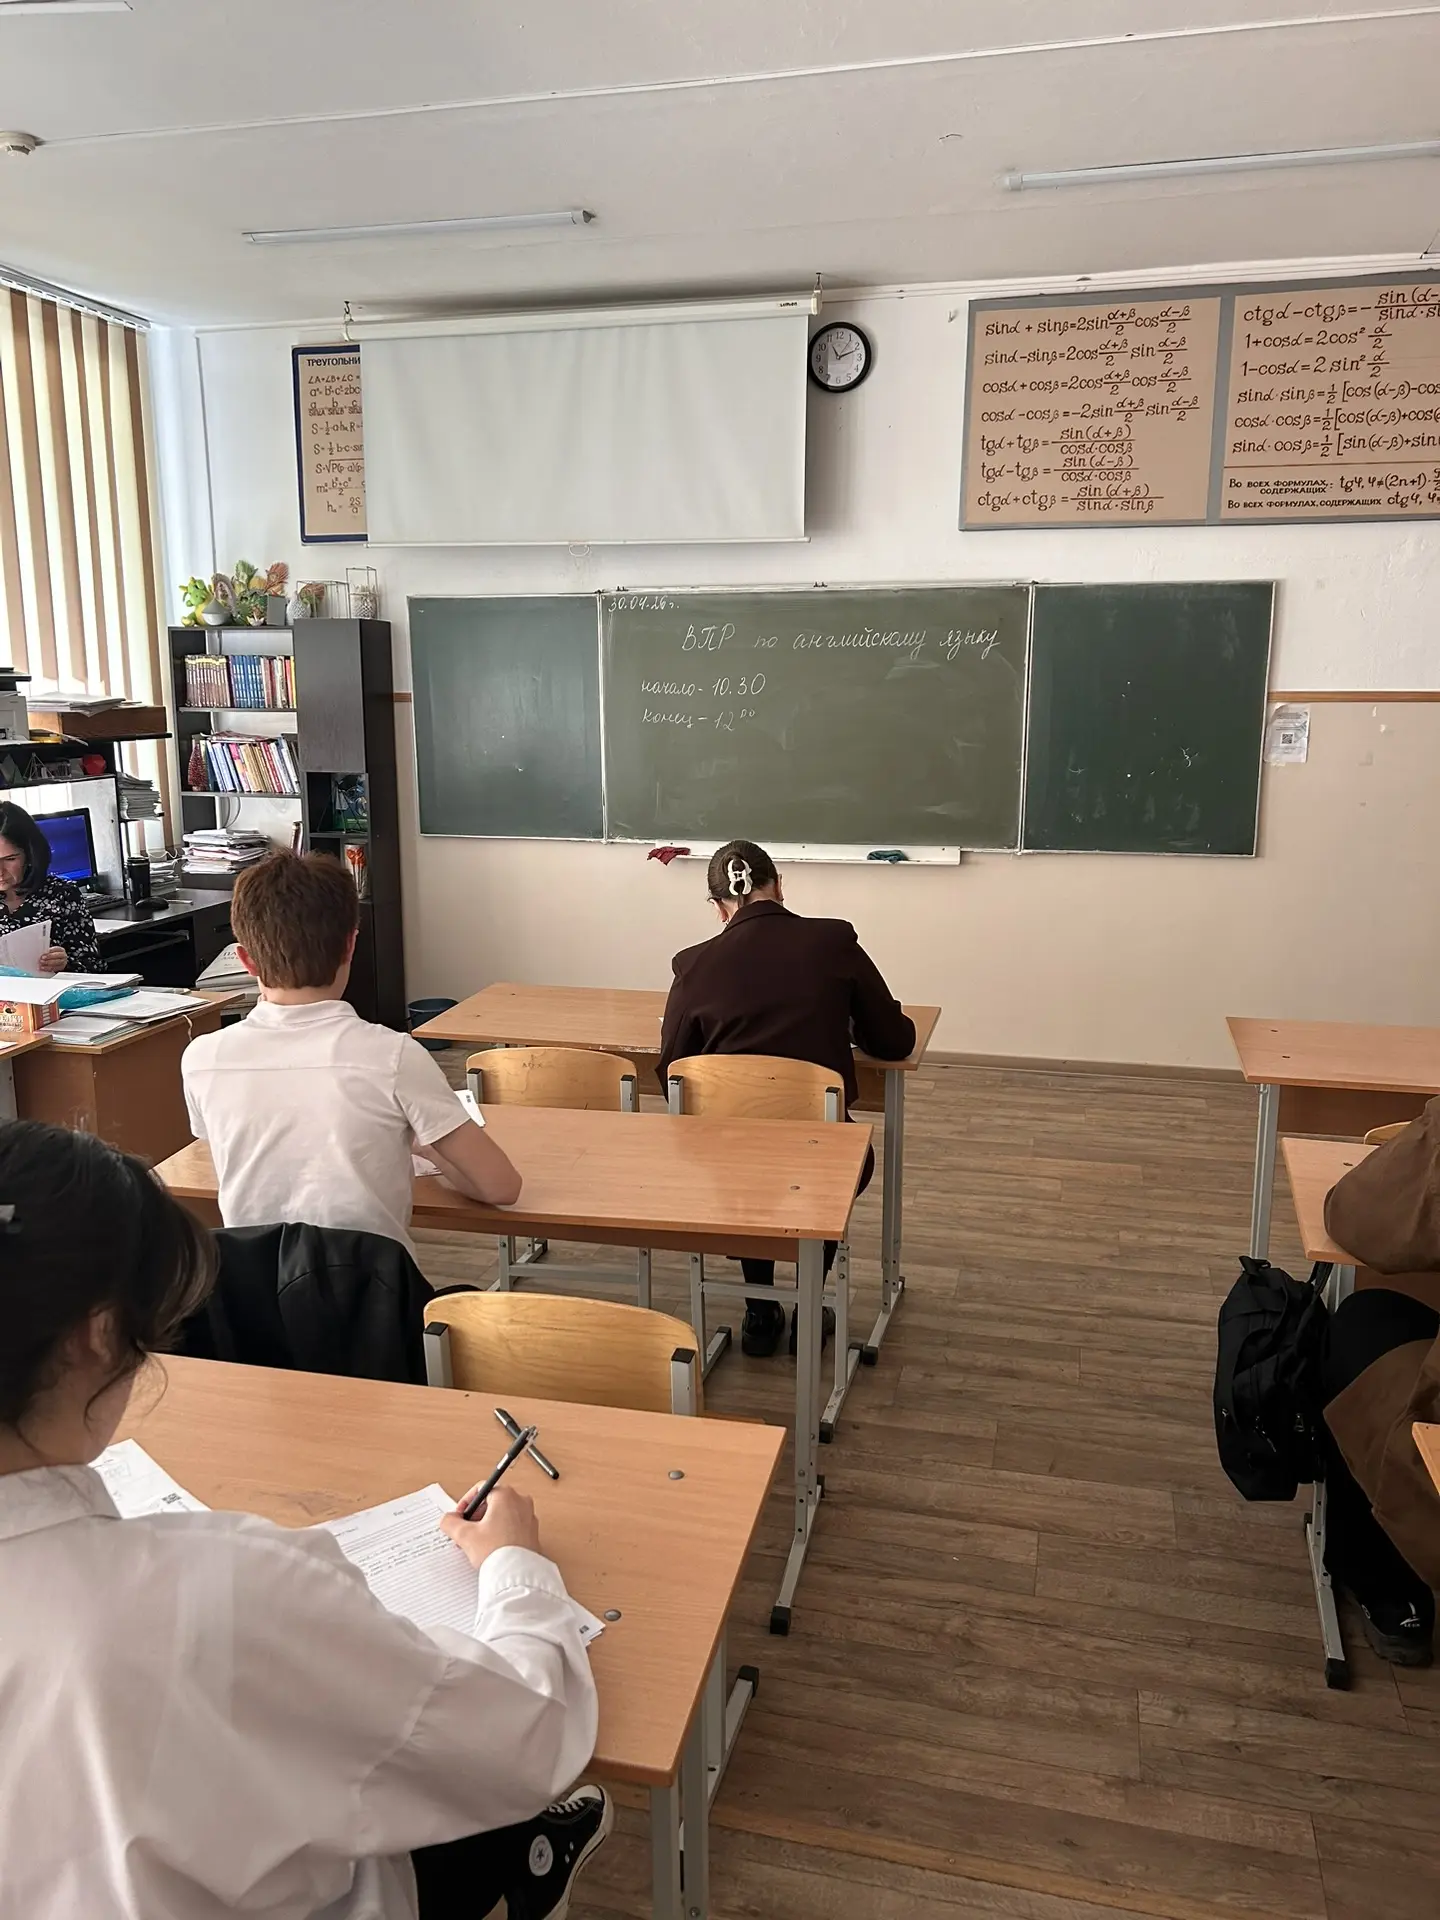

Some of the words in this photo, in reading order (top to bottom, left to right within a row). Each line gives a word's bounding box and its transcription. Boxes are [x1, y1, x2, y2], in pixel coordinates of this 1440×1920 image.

[682, 623, 736, 651] ВПР
[754, 635, 779, 648] по
[793, 627, 927, 660] английскому
[939, 628, 1000, 660] языку
[712, 672, 766, 696] 10.30
